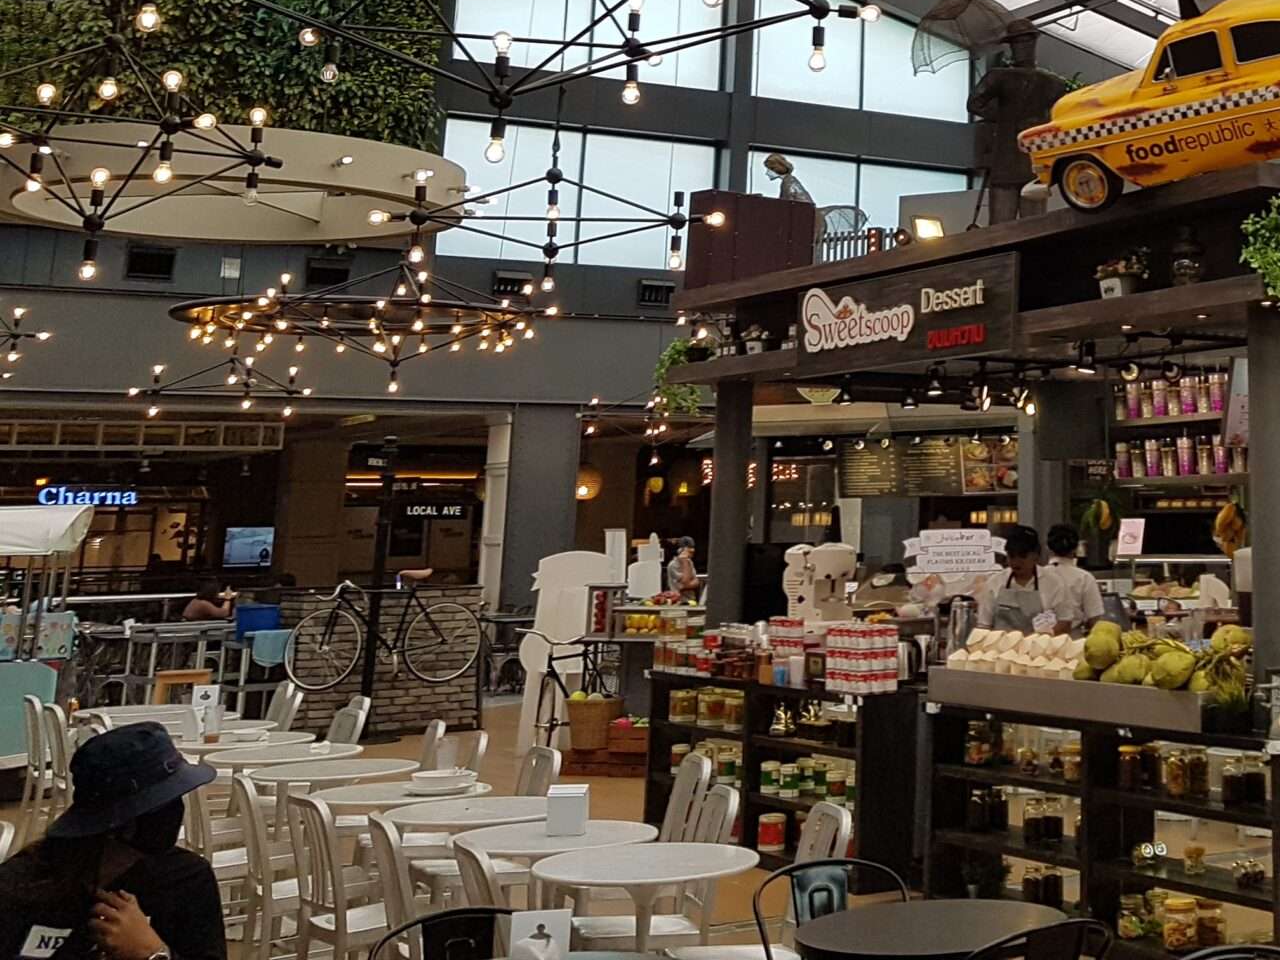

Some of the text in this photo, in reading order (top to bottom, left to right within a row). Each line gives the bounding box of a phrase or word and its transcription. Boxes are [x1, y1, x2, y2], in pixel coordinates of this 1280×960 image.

[1125, 119, 1255, 162] foodrepublic
[920, 279, 985, 314] Dessert
[806, 296, 911, 347] Sweetscoop
[38, 486, 138, 505] Charna
[406, 505, 462, 516] LOCAL AVE
